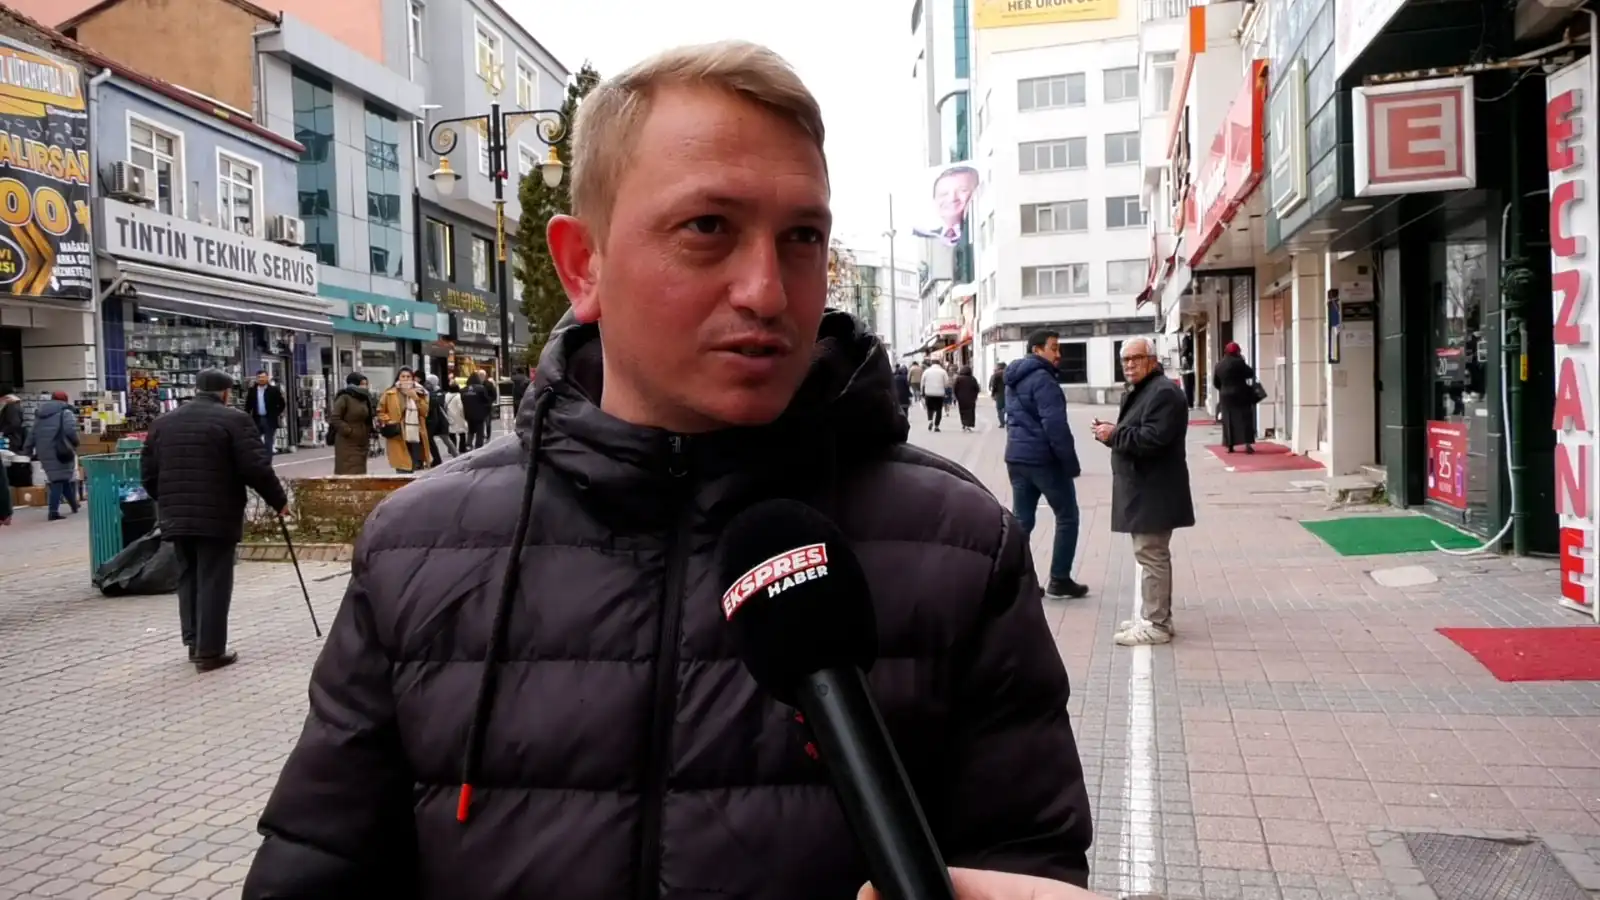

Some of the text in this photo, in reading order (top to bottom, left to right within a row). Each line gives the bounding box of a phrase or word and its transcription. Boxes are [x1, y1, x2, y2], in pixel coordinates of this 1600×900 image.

[1008, 0, 1032, 12] HER
[1387, 103, 1446, 170] E
[115, 213, 314, 286] TİNTİN TEKNİK SERVİS
[1547, 89, 1588, 605] ECZANE
[723, 548, 822, 617] EKSPRES
[767, 565, 828, 598] HABER
